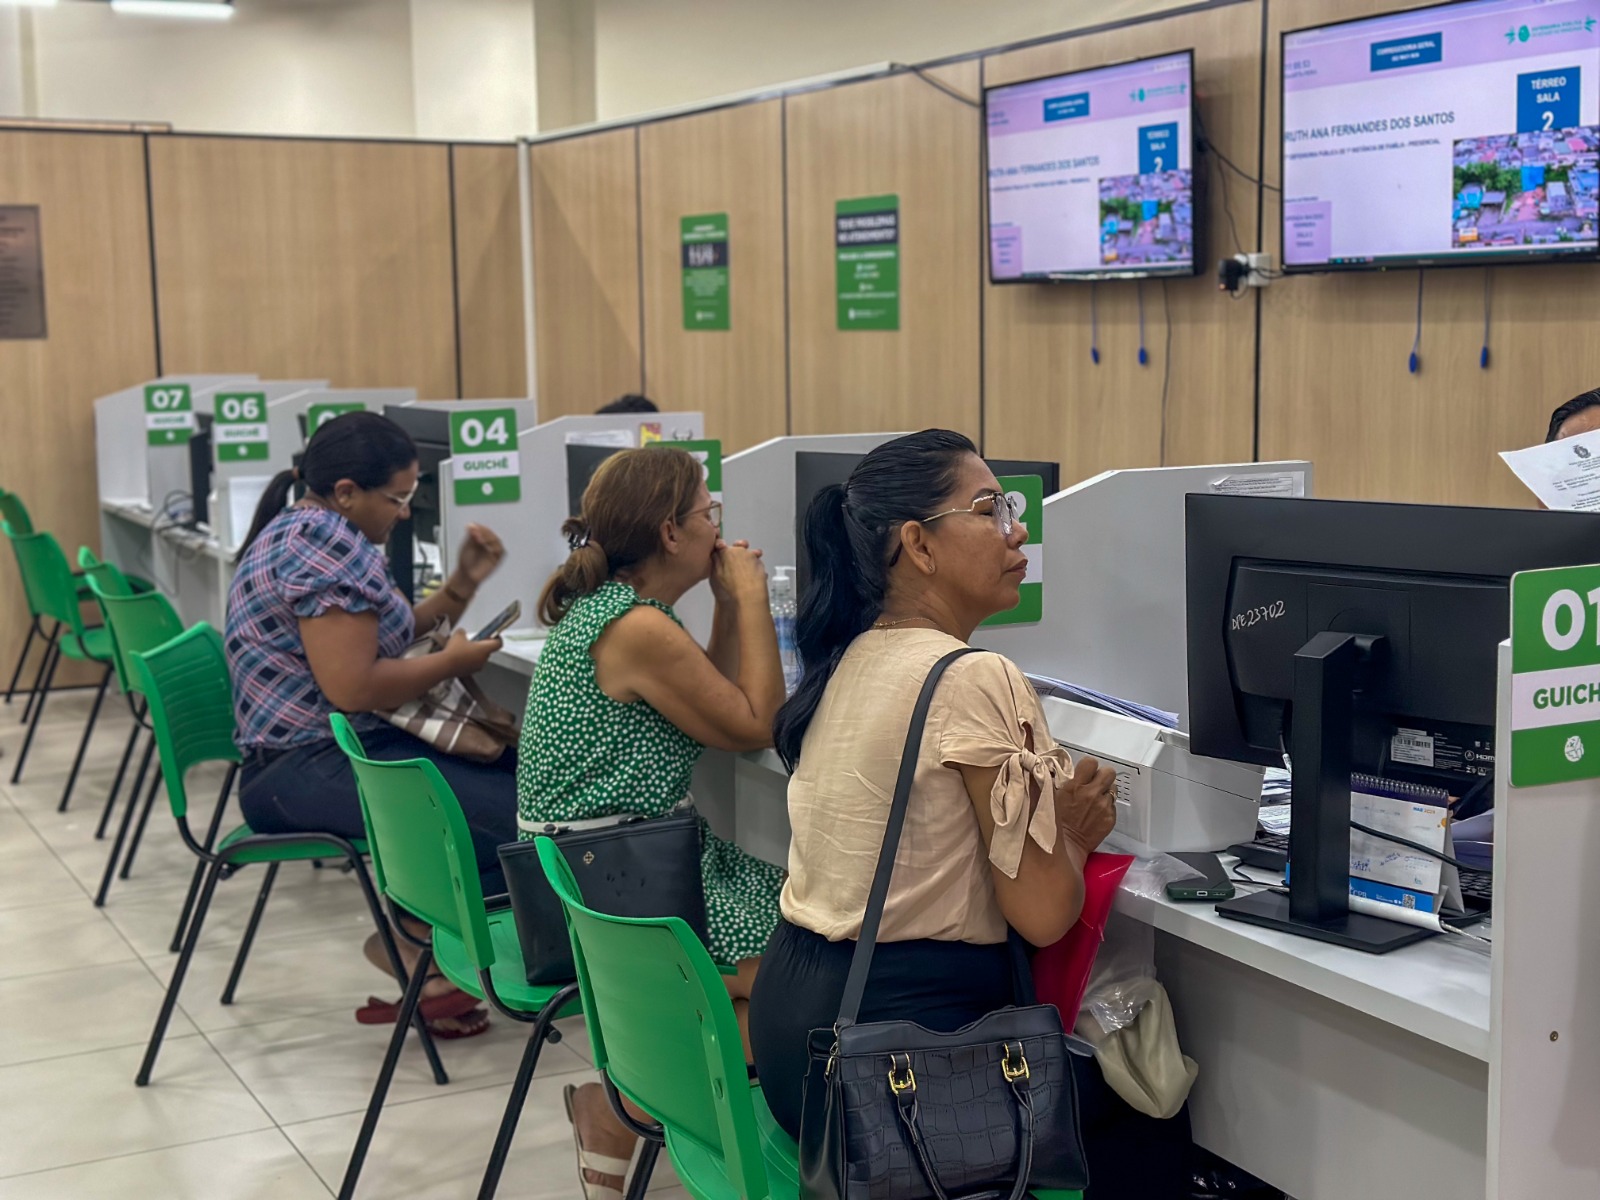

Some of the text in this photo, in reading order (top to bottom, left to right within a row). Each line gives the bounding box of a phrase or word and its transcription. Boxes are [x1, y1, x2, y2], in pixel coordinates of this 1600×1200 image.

[1531, 76, 1567, 90] TÉRREO
[1536, 91, 1560, 104] SALA
[1311, 126, 1330, 139] ANA
[1331, 119, 1388, 137] FERNANDES
[1390, 116, 1411, 130] DOS
[1414, 111, 1455, 128] SANTOS
[1542, 111, 1554, 131] 2
[152, 389, 184, 409] 07
[222, 397, 259, 420] 06
[461, 416, 509, 447] 04
[463, 457, 508, 471] GUICHÊ
